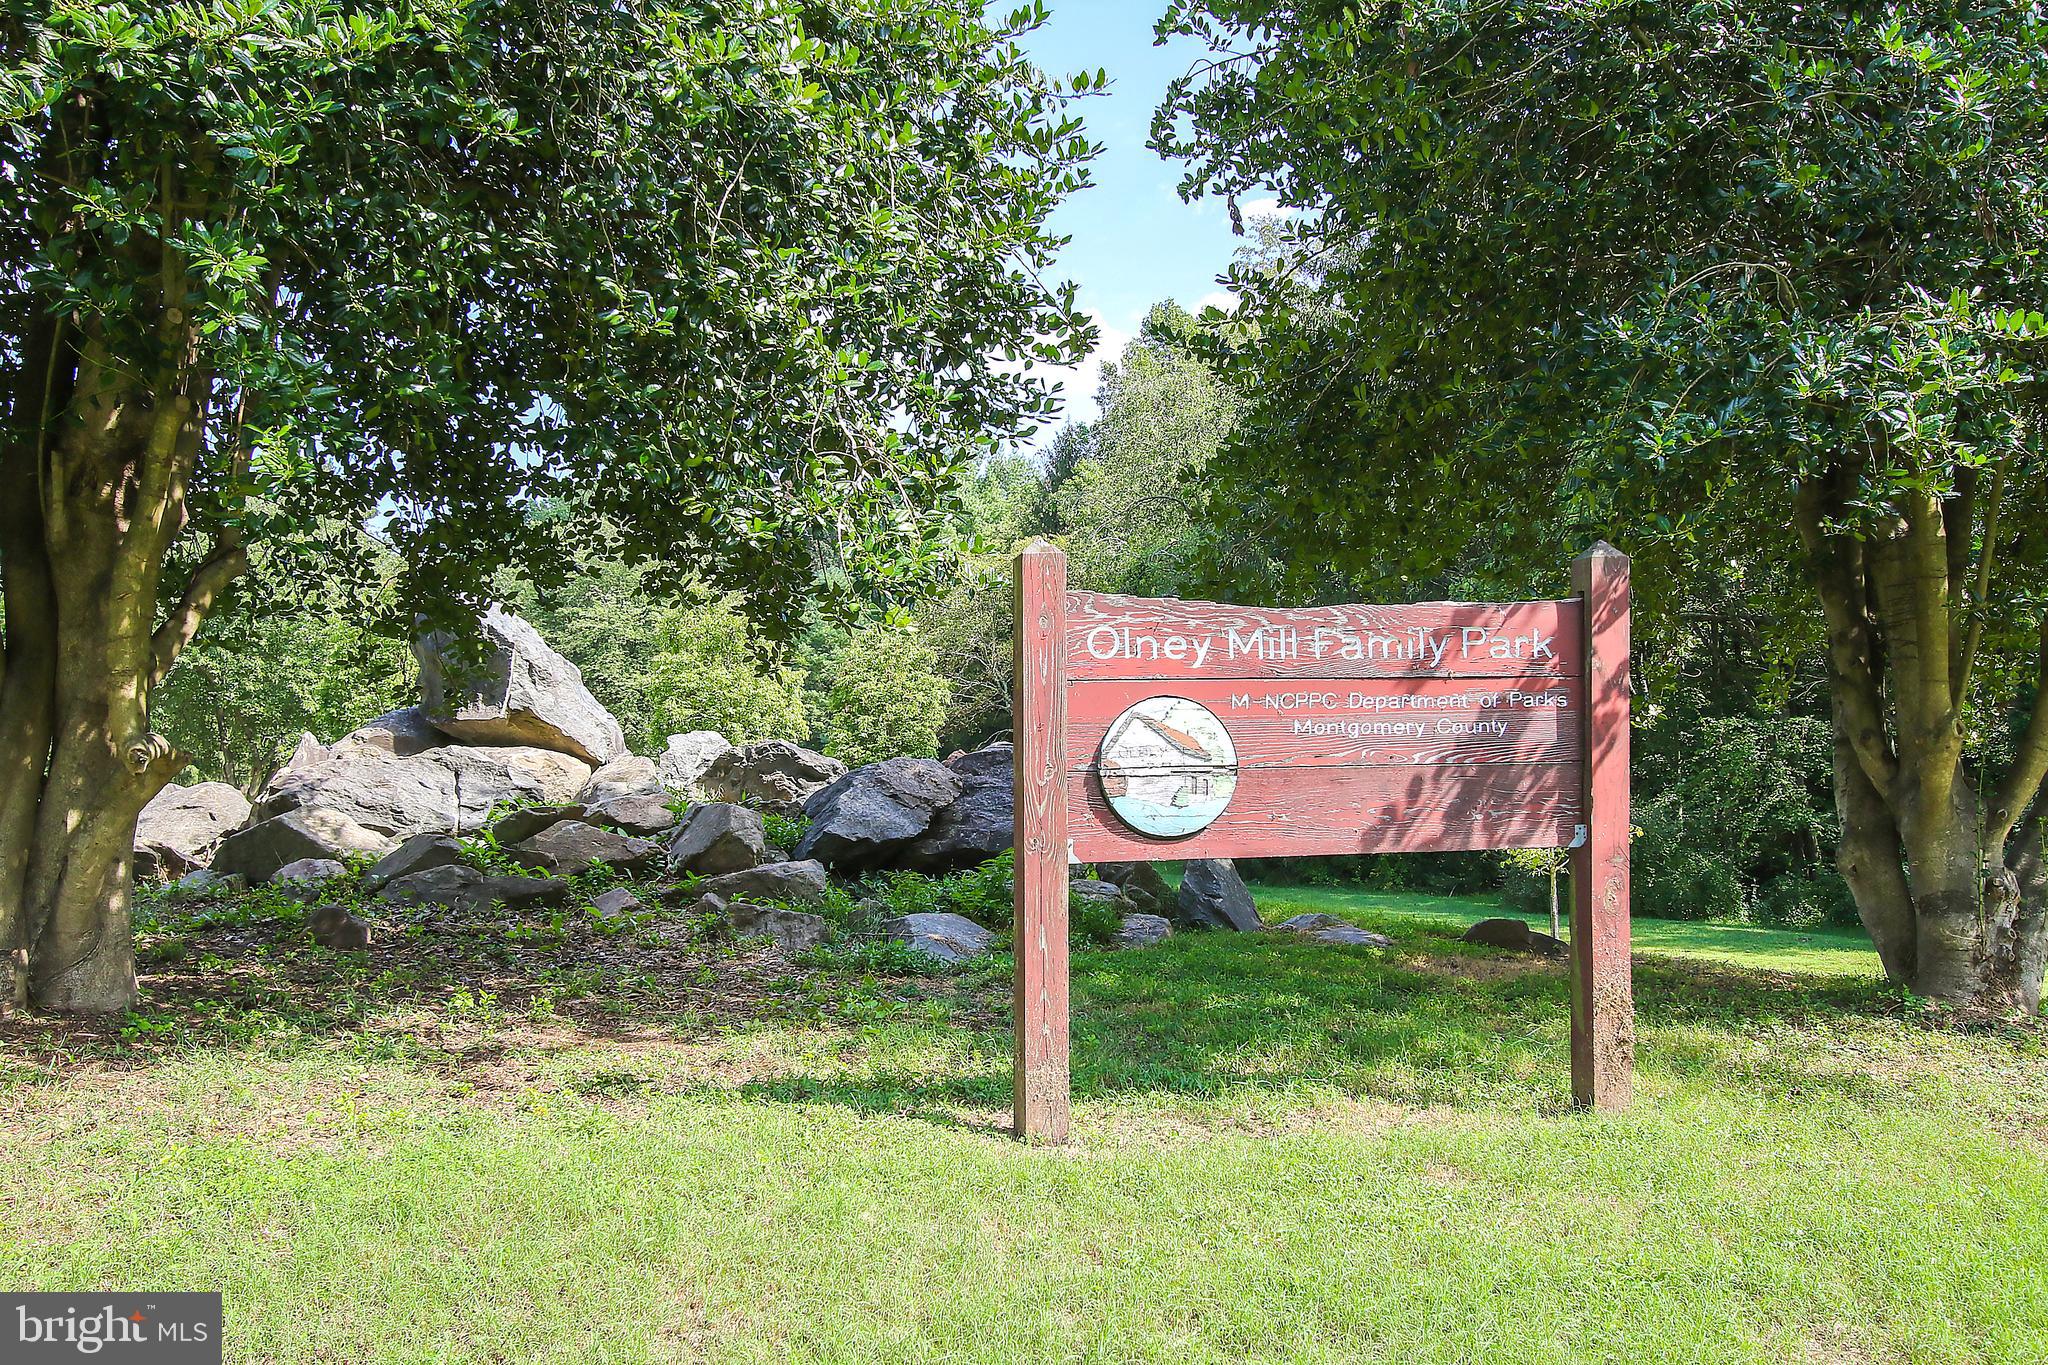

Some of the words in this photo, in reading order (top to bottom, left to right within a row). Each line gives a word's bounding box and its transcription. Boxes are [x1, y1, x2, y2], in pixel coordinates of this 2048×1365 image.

[1086, 625, 1212, 669] Olney
[1228, 626, 1298, 661] Mill
[1313, 625, 1448, 668] Family
[1462, 626, 1553, 660] Park
[1349, 691, 1471, 713] Department
[1480, 692, 1500, 709] of
[1508, 691, 1568, 708] Parks
[1293, 718, 1425, 738] Montgomery
[1436, 717, 1508, 738] County
